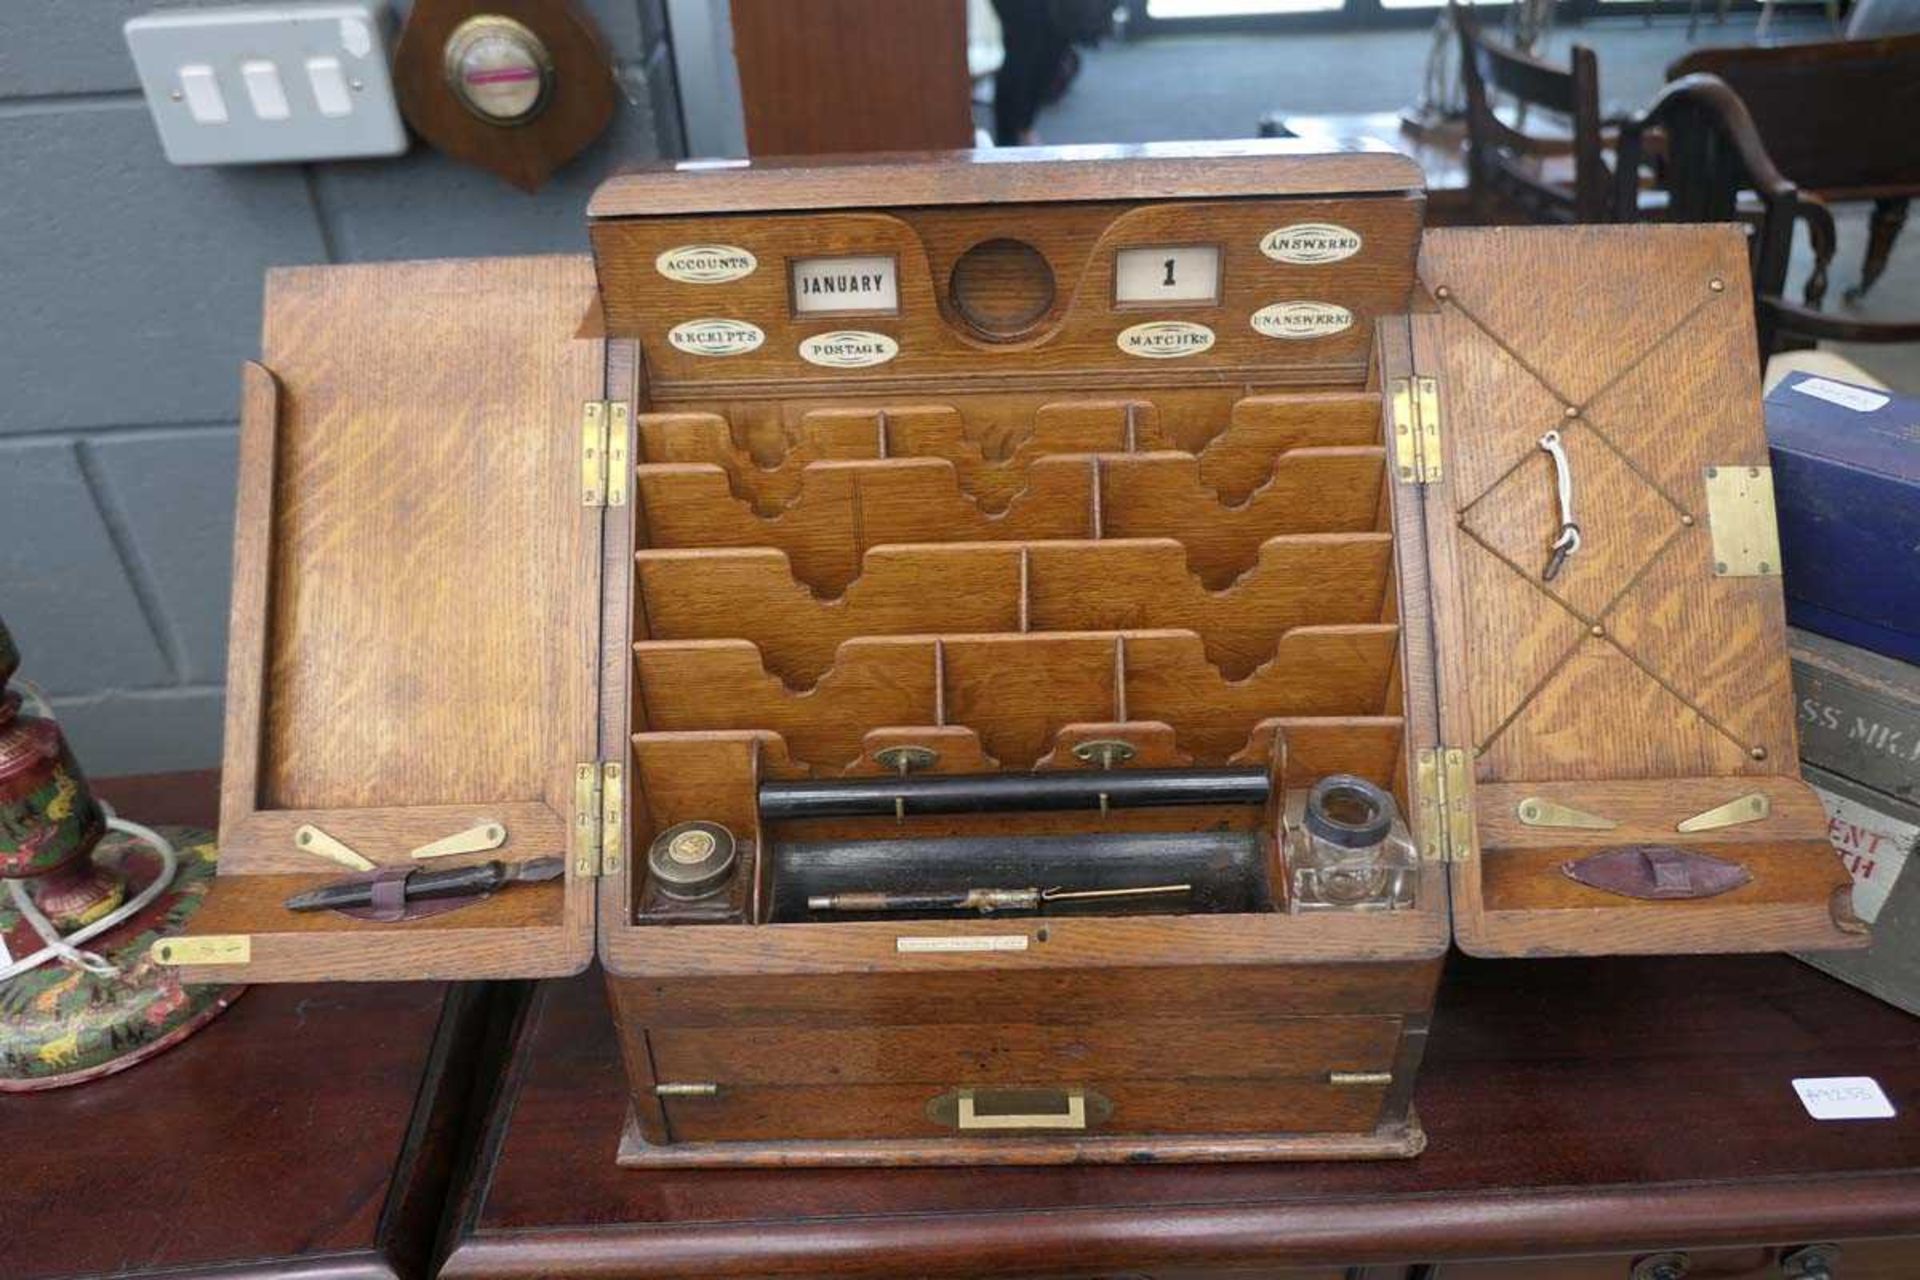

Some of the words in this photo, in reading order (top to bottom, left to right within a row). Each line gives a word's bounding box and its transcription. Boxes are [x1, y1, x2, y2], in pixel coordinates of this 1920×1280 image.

[1268, 238, 1358, 250] ANSWERED
[667, 257, 750, 270] ACCOUNTS
[1163, 259, 1176, 286] 1
[803, 274, 882, 294] JANUARY
[674, 331, 758, 344] RECEIPTS
[1129, 333, 1208, 346] MATCHES
[813, 344, 884, 355] POSTAGE
